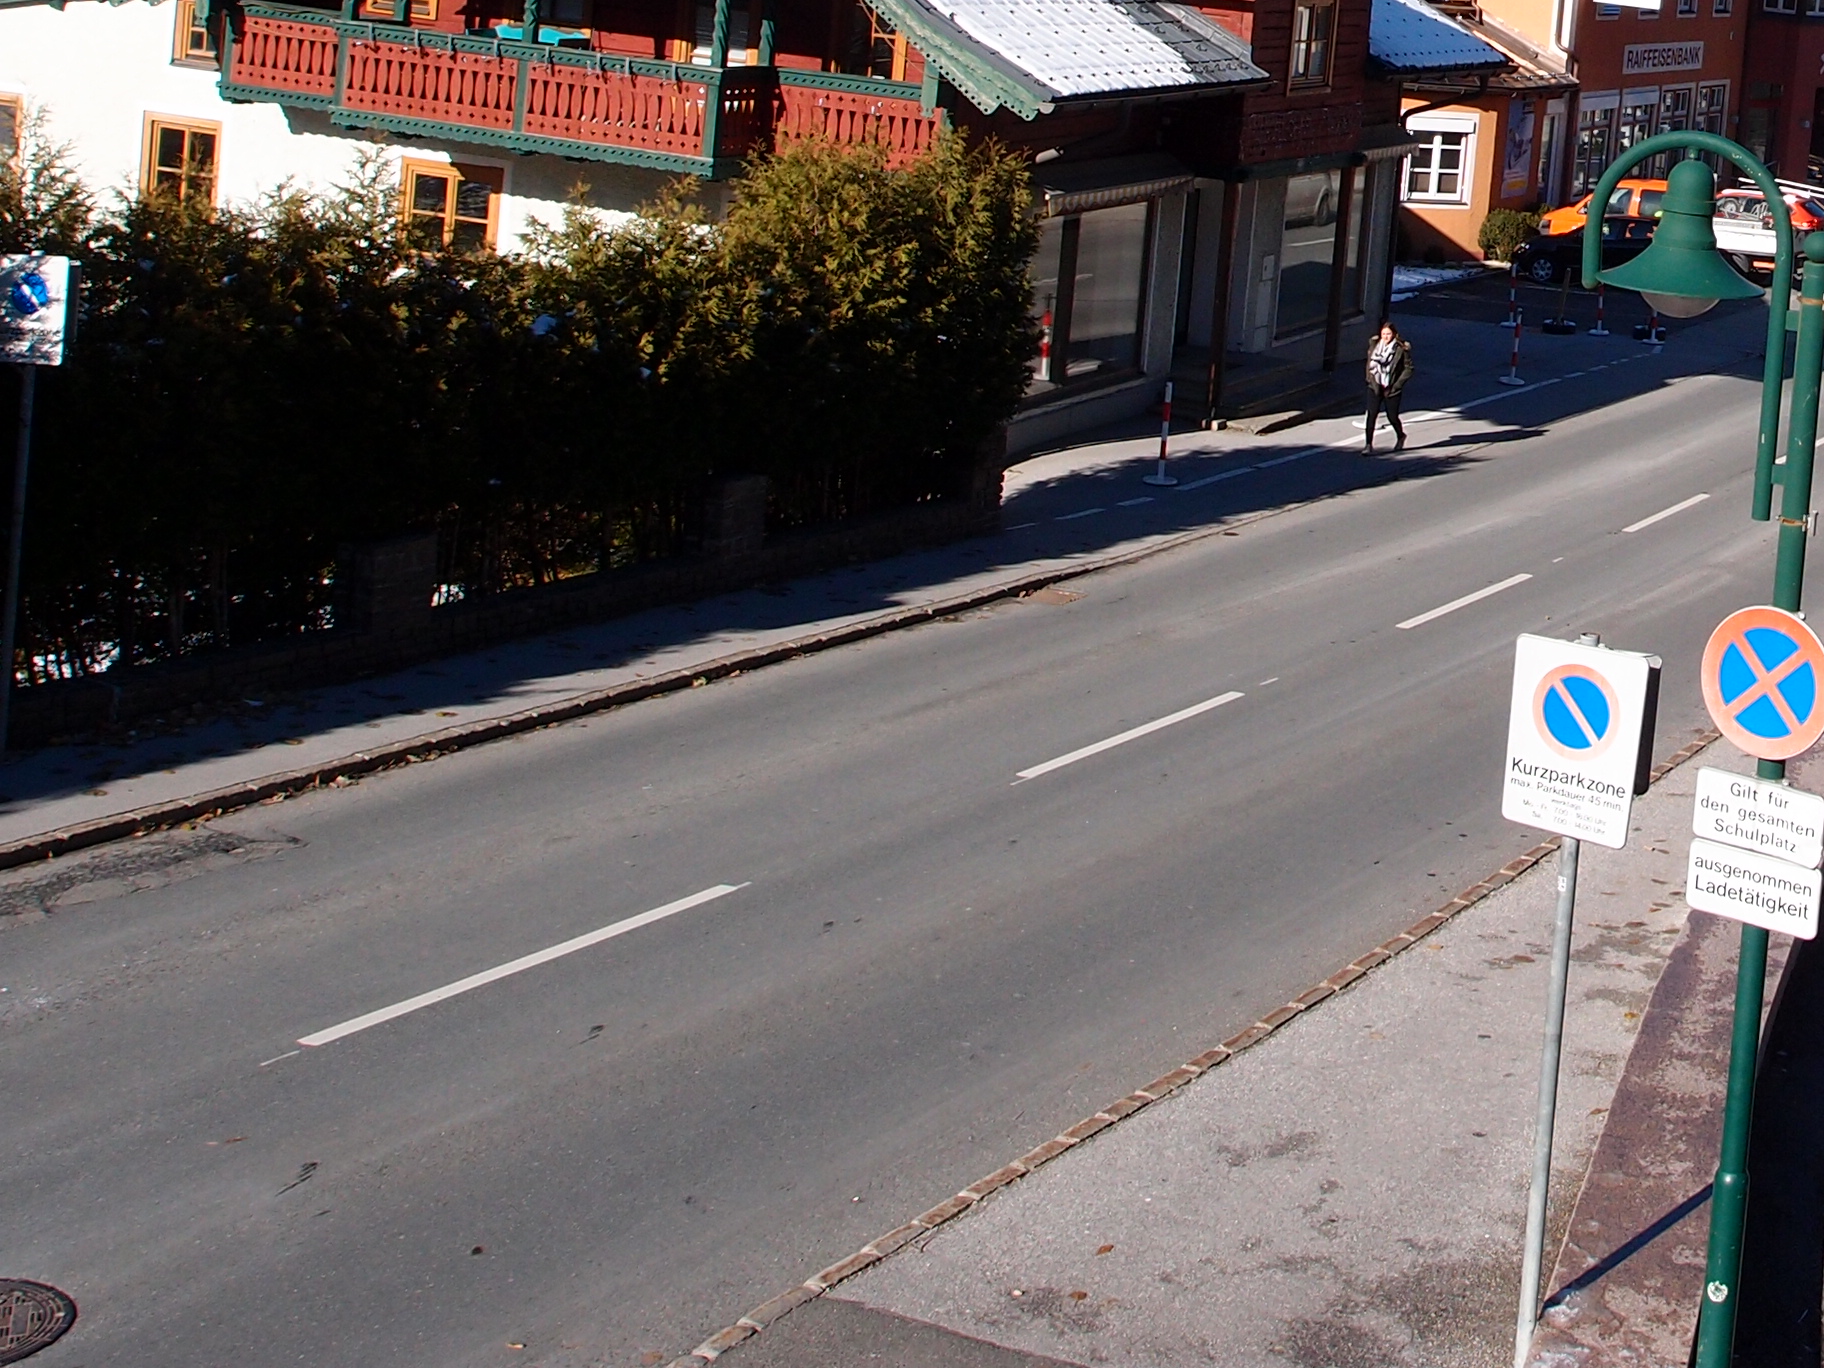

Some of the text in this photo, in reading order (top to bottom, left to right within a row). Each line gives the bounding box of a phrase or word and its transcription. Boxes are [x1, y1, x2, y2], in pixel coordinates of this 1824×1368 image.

[1626, 47, 1701, 69] RAIFFEISENBANK
[1510, 777, 1624, 813] max. Parkdauer 45 min.
[1511, 757, 1626, 799] Kurzparkzone
[1729, 781, 1789, 810] Gilt für
[1700, 795, 1815, 839] den gesamten
[1714, 817, 1797, 854] Schulplatz
[1694, 855, 1813, 898] ausgenommen
[1694, 875, 1809, 920] Ladetätigkeit
